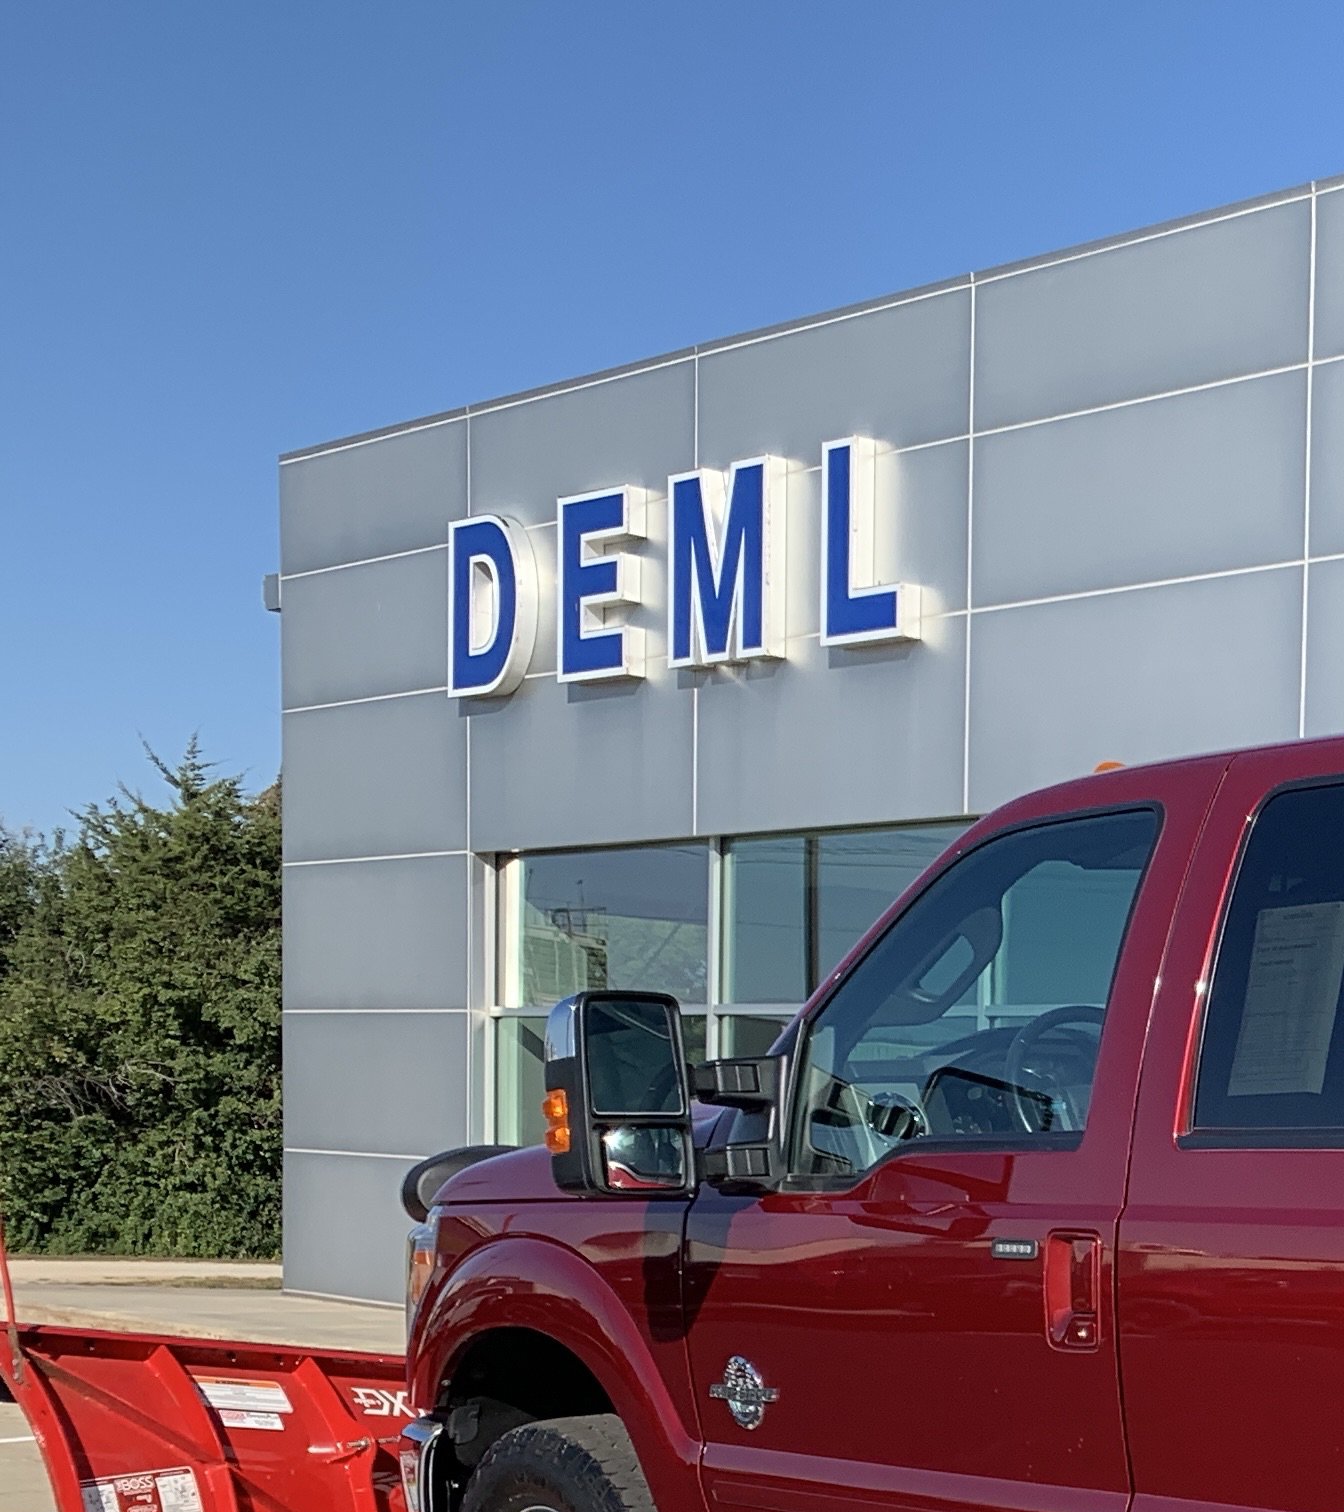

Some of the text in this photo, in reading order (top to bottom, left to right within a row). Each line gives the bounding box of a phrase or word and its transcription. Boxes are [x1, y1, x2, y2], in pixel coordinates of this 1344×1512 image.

[448, 435, 921, 698] DEML
[351, 1387, 425, 1418] DX
[121, 1475, 154, 1491] BOSS
